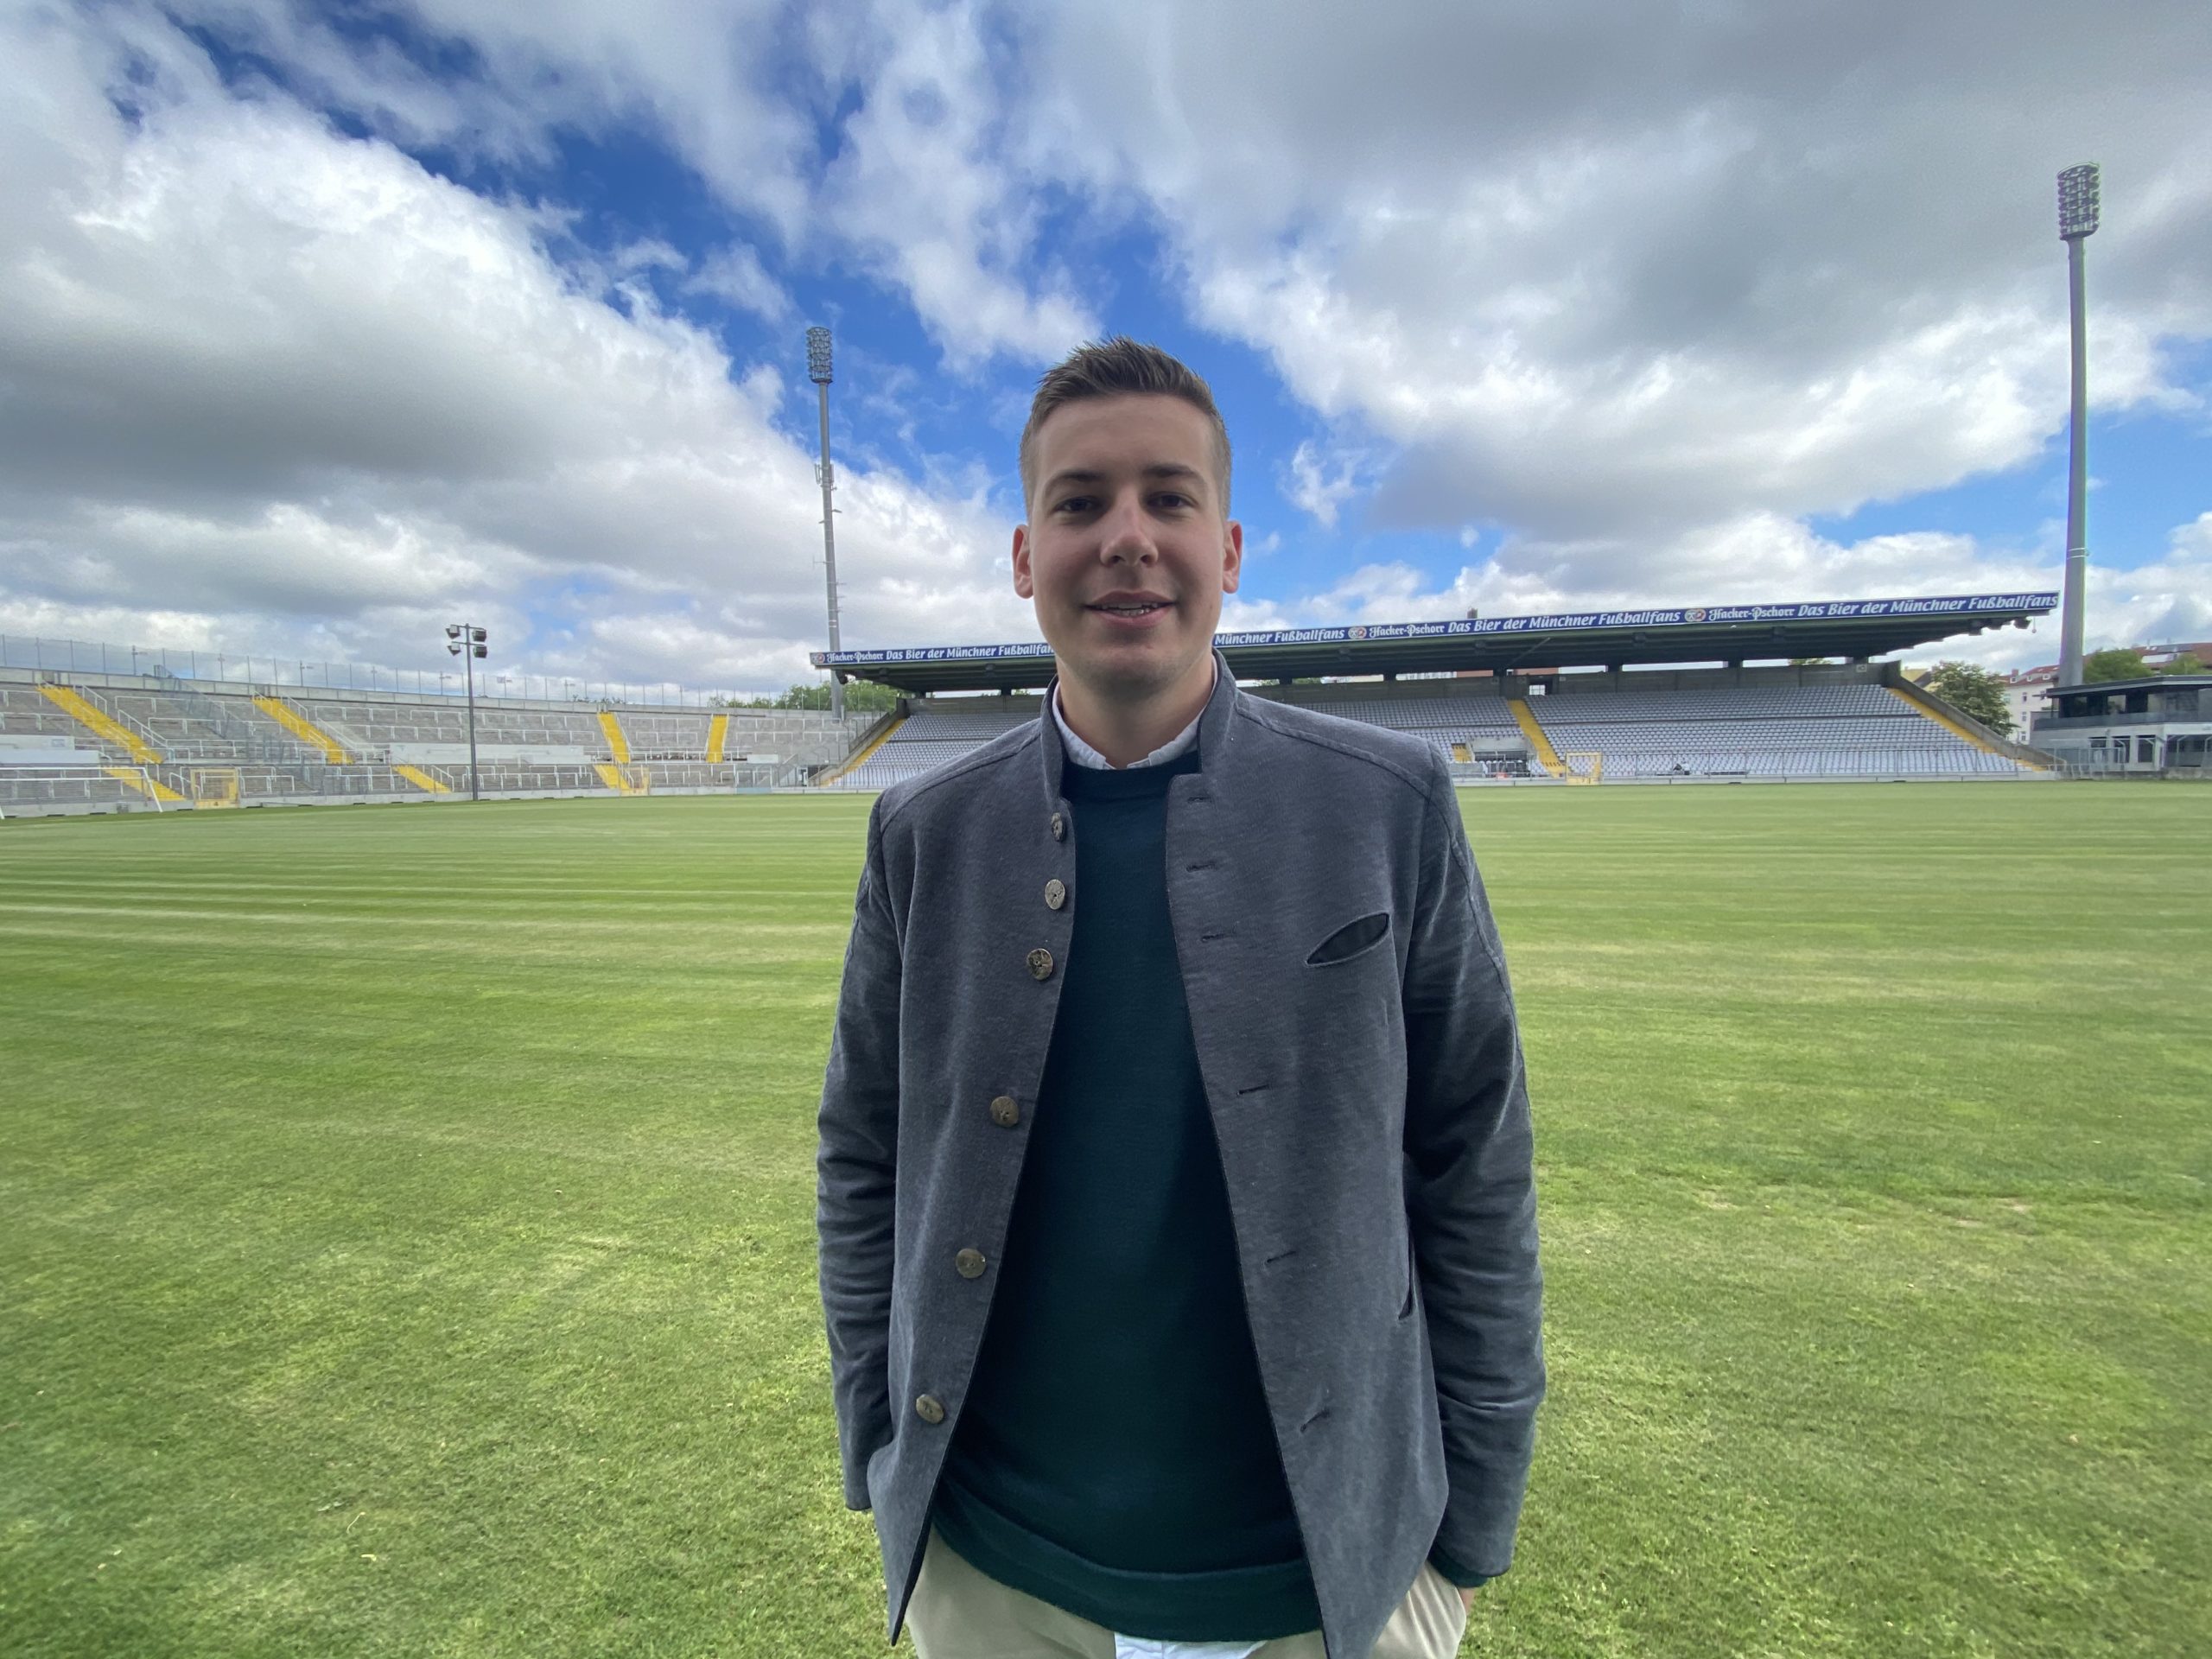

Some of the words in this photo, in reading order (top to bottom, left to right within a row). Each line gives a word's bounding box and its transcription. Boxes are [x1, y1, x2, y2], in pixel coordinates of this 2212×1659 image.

[1798, 605, 1825, 617] Das
[1827, 603, 1859, 615] Bier
[1860, 602, 1887, 614] der
[1890, 599, 1966, 613] Münchner
[1968, 595, 2057, 608] Fußballfans
[1447, 621, 1471, 633] Das
[1474, 620, 1501, 632] Bier
[1503, 618, 1527, 629] der
[1529, 614, 1595, 628] Münchner
[1599, 611, 1681, 625] Fußballfans
[1215, 632, 1271, 645] Münchner
[1274, 628, 1344, 642] Fußballfans
[886, 651, 904, 660] Das
[906, 648, 926, 659] Bier
[927, 648, 944, 658] der
[947, 646, 997, 658] Münchner
